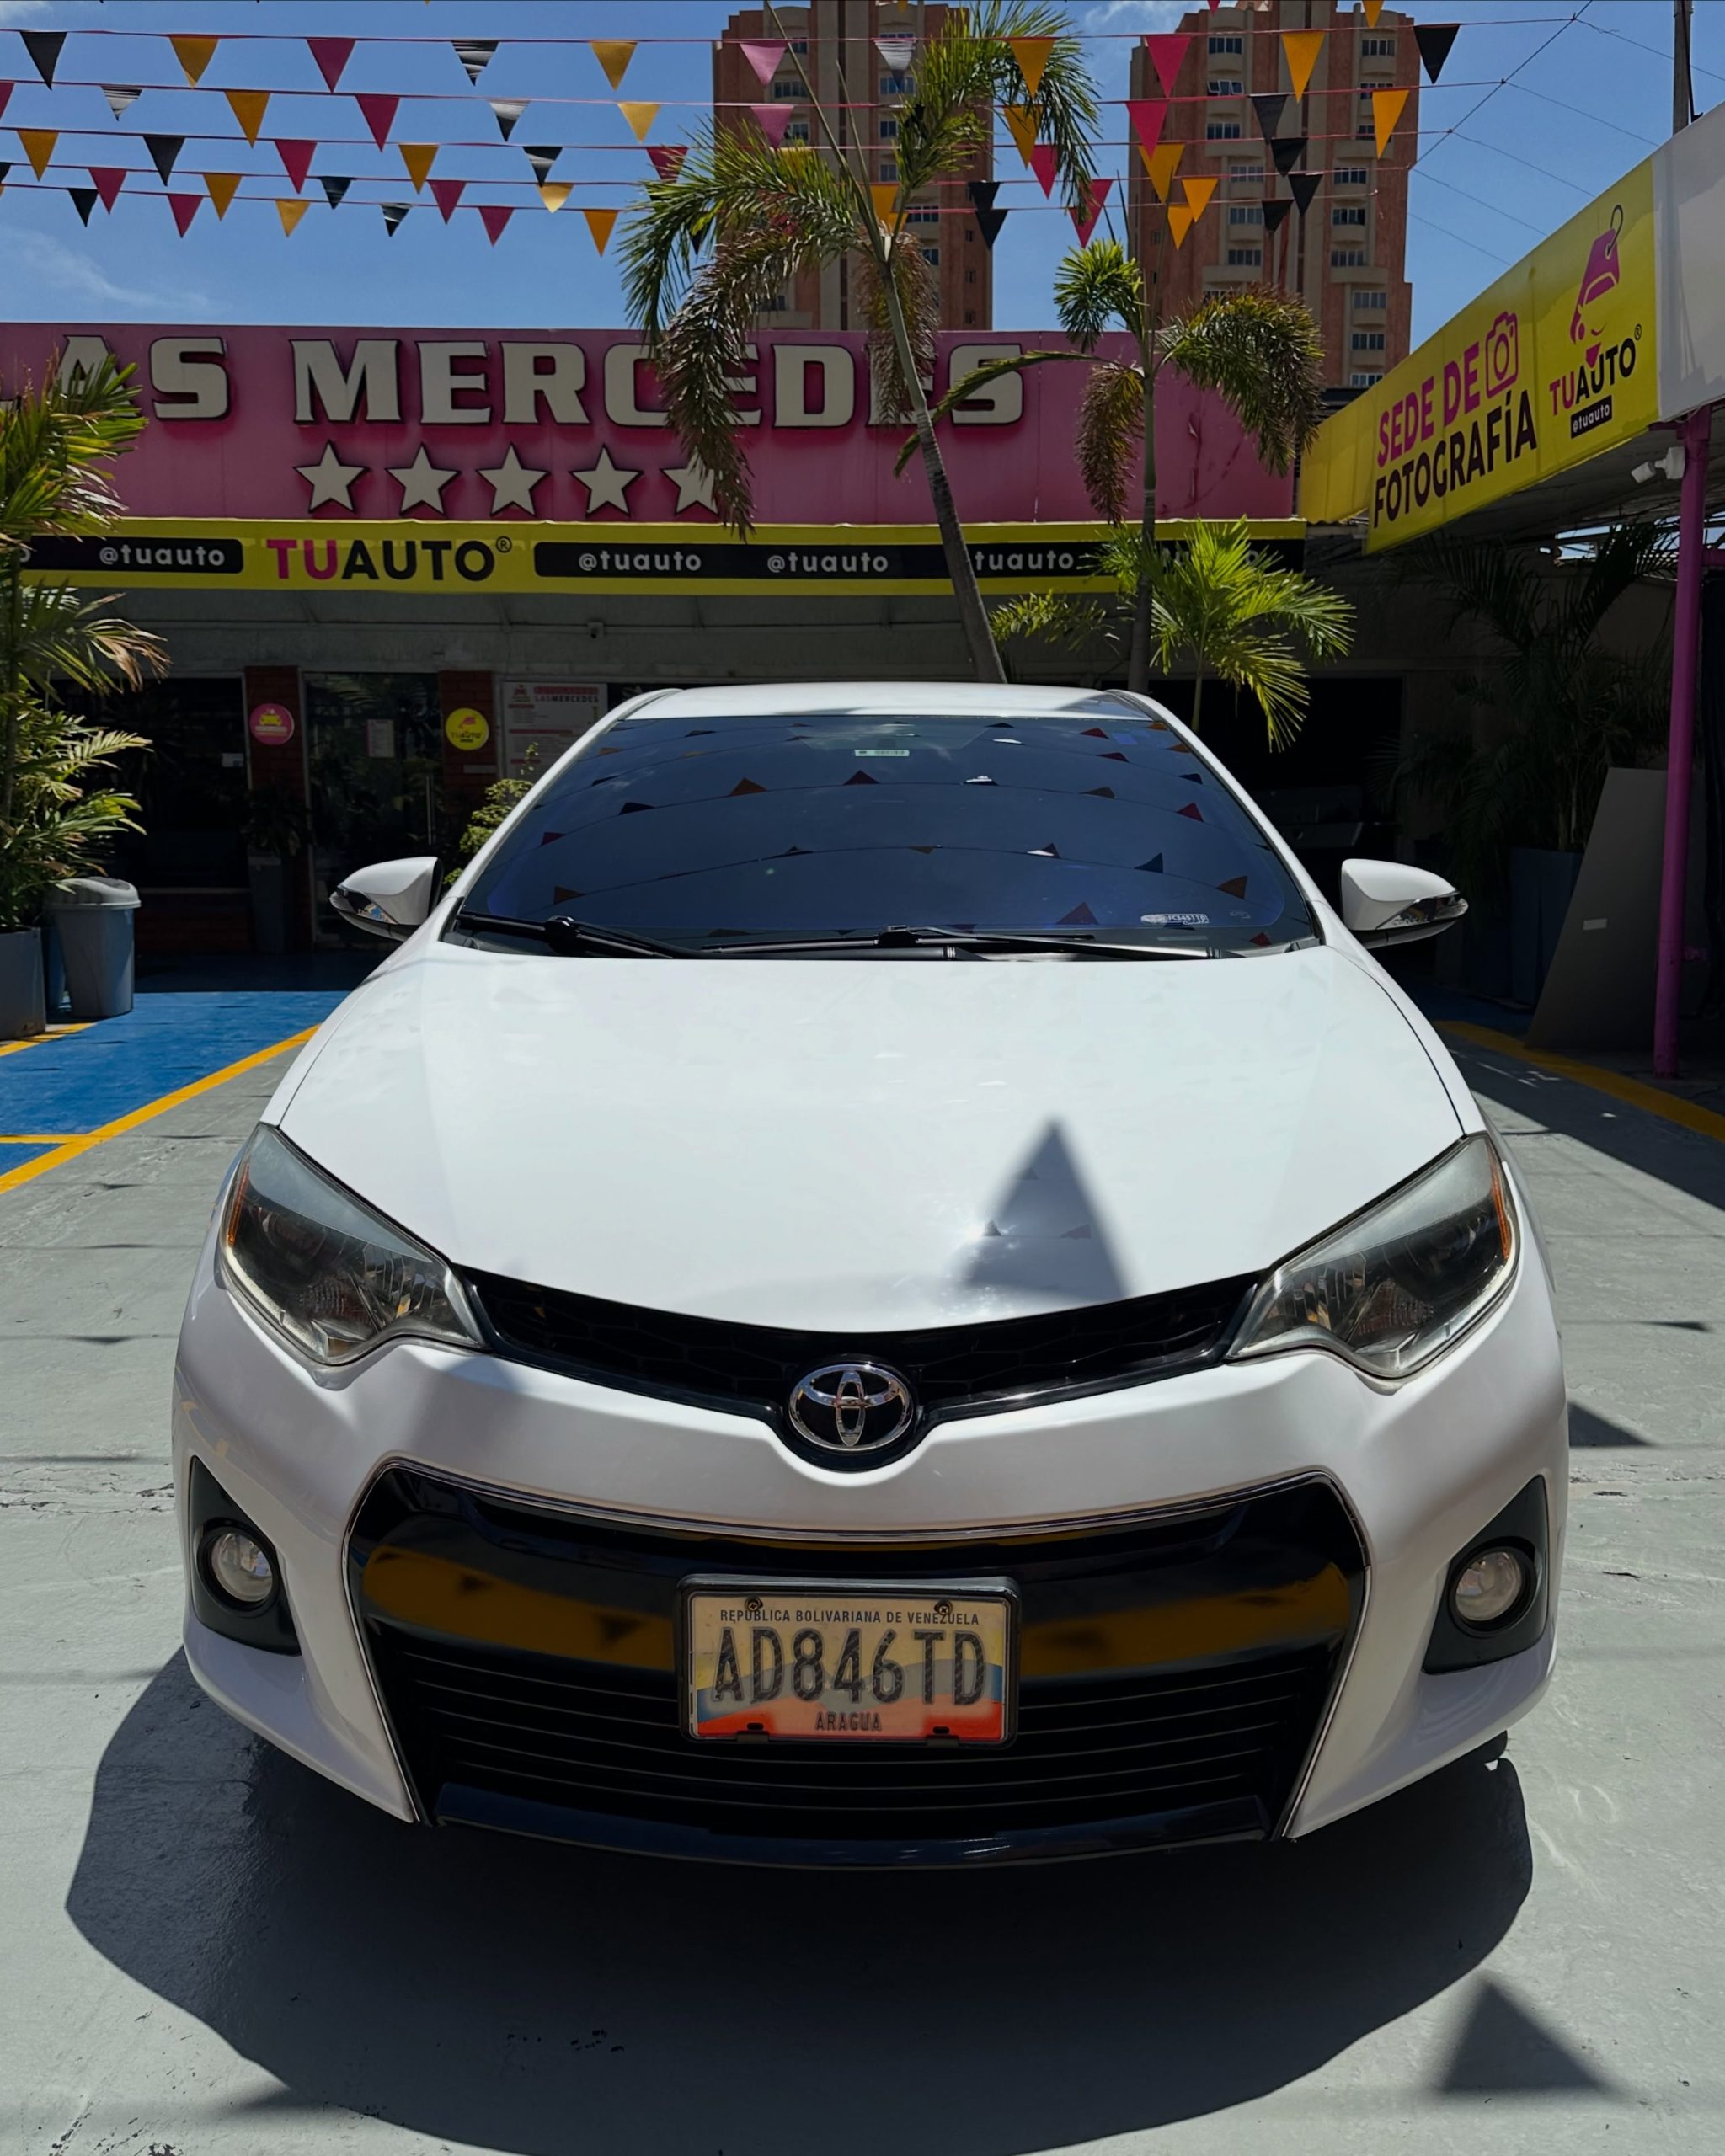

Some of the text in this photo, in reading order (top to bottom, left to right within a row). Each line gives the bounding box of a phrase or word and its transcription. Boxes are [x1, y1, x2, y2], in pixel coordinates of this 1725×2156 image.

[0, 335, 229, 419] AS
[1377, 341, 1481, 467] SEDE DE
[1572, 403, 1610, 433] @tuauto
[1373, 390, 1537, 528] FOTOGRAFÍA
[99, 545, 226, 568] @tuauto
[579, 549, 1075, 573] @tuauto @tuauto tuauto
[795, 1610, 881, 1623] BOLIVARIANA
[886, 1611, 902, 1624] DE
[907, 1611, 979, 1625] VENEZUELA
[712, 1626, 986, 1705] AD846TD
[815, 1711, 883, 1732] ARAGUA
